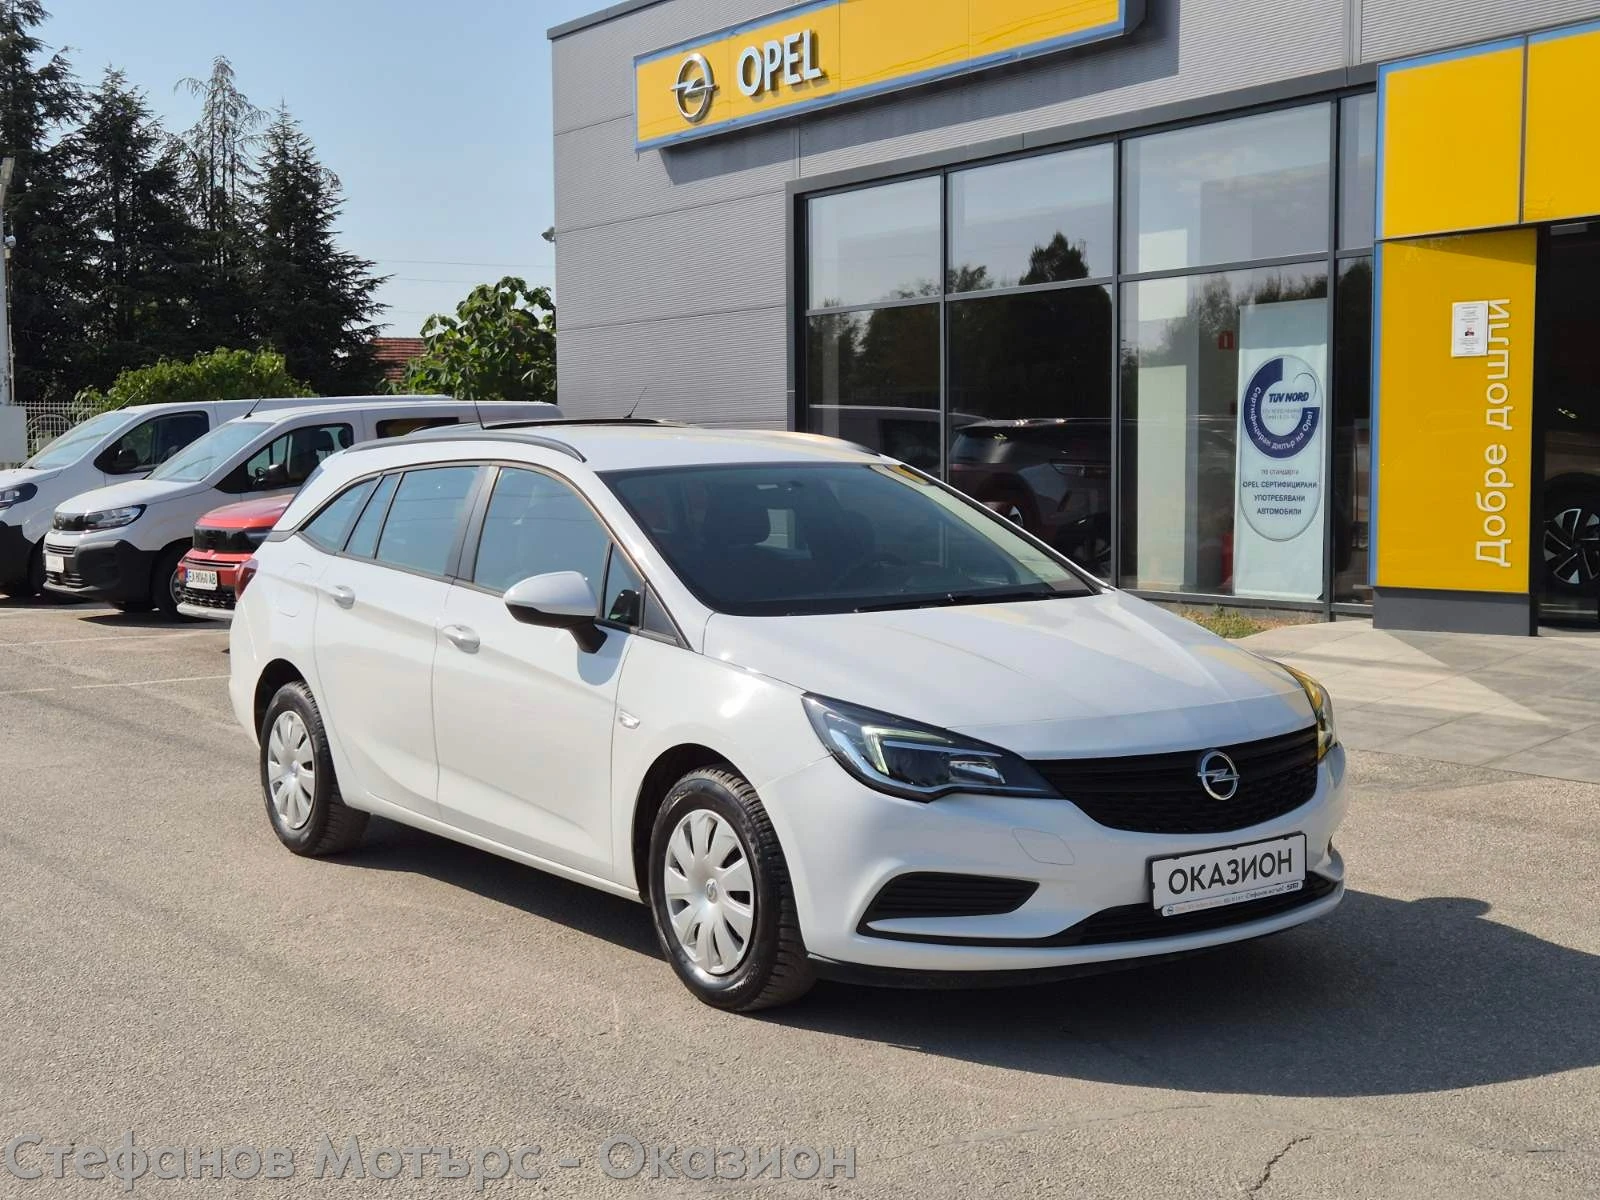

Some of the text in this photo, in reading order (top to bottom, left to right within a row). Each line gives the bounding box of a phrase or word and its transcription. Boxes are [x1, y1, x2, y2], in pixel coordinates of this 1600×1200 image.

[737, 29, 822, 96] OPEL
[1285, 392, 1309, 402] NORD
[1302, 411, 1313, 431] Opel
[1475, 298, 1514, 568] Добре дошли
[1254, 494, 1306, 502] УПОТРЕБЯВАНИ
[1168, 848, 1292, 894] ОКАЗИОН
